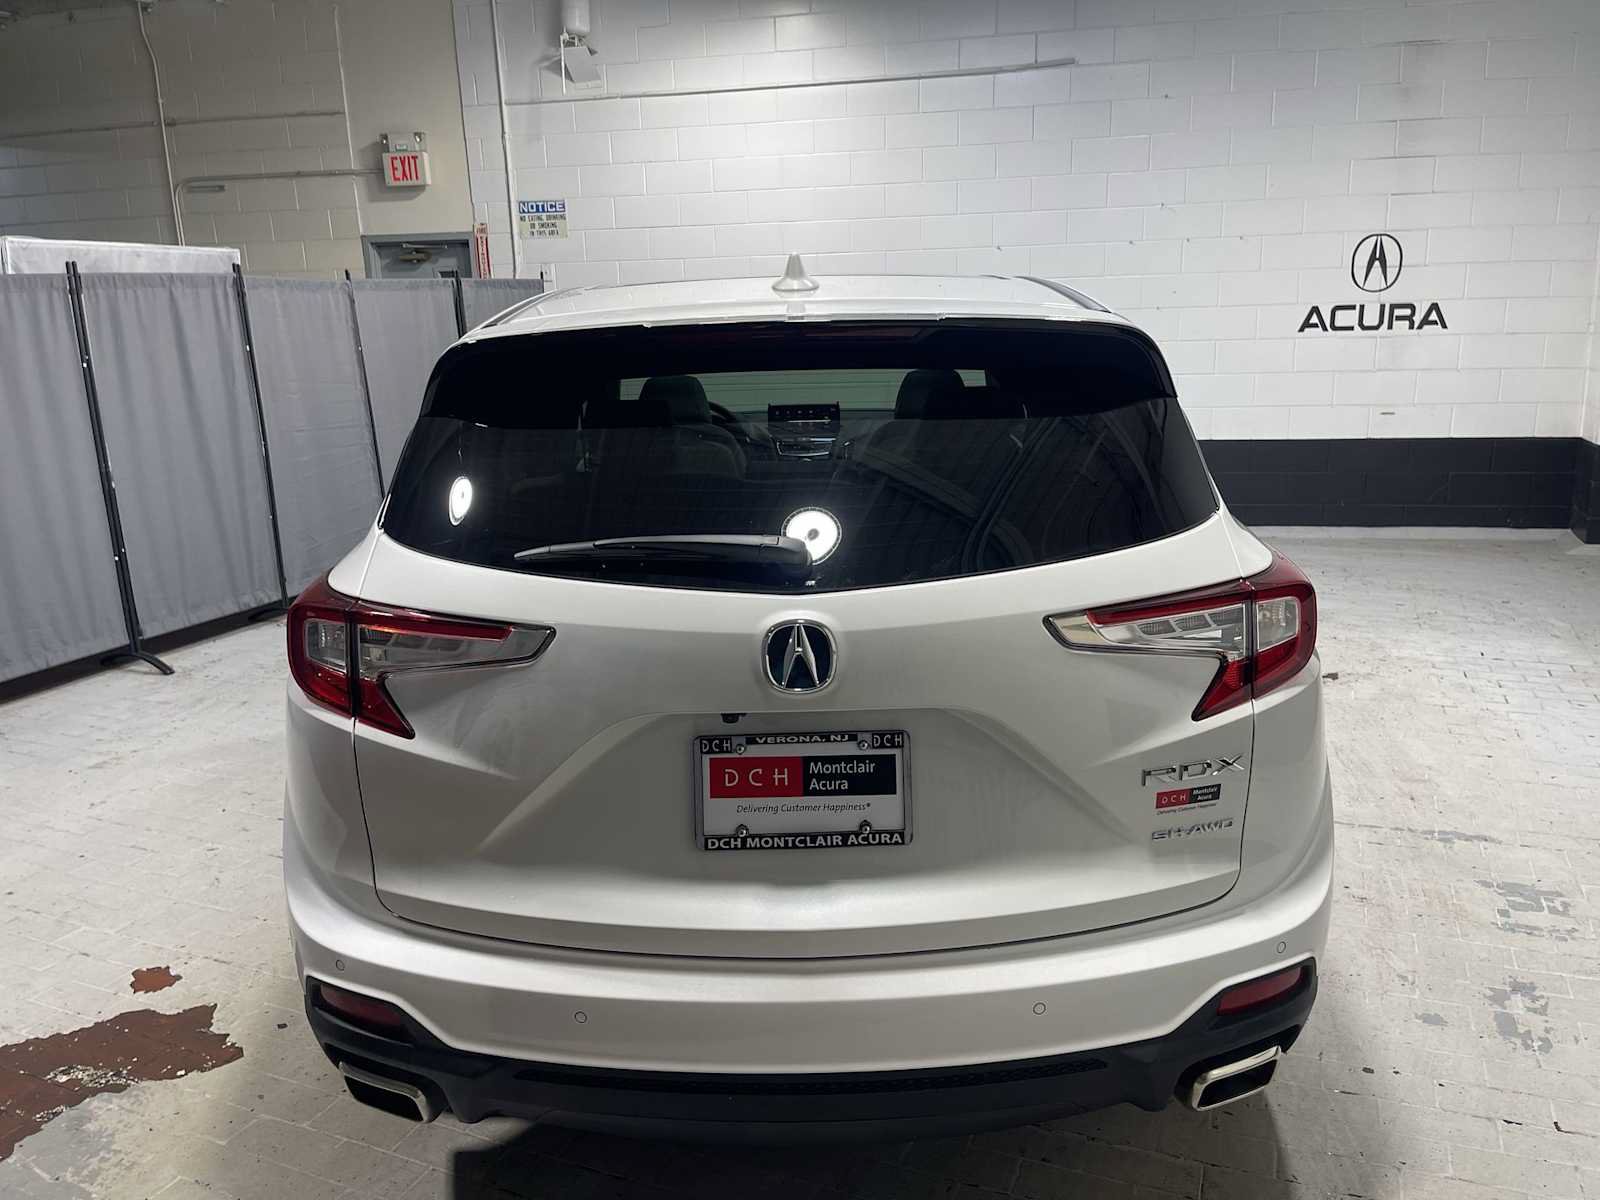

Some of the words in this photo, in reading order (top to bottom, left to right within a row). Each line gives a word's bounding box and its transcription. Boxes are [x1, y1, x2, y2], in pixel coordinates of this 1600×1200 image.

[390, 155, 419, 181] EXIT
[519, 201, 565, 213] NOTICE
[1297, 302, 1448, 333] ACURA
[756, 734, 826, 744] VERONA,
[830, 734, 849, 742] NJ
[873, 734, 903, 746] DCH
[702, 740, 731, 752] DCH
[809, 760, 876, 774] Montclair
[1141, 754, 1245, 787] RDX
[724, 768, 789, 787] DCH
[809, 778, 848, 790] Acura
[736, 803, 779, 814] Delivering
[781, 803, 821, 813] Customer
[707, 838, 741, 849] DCH
[746, 835, 842, 848] MONTCLAIR
[847, 833, 902, 845] ACURA
